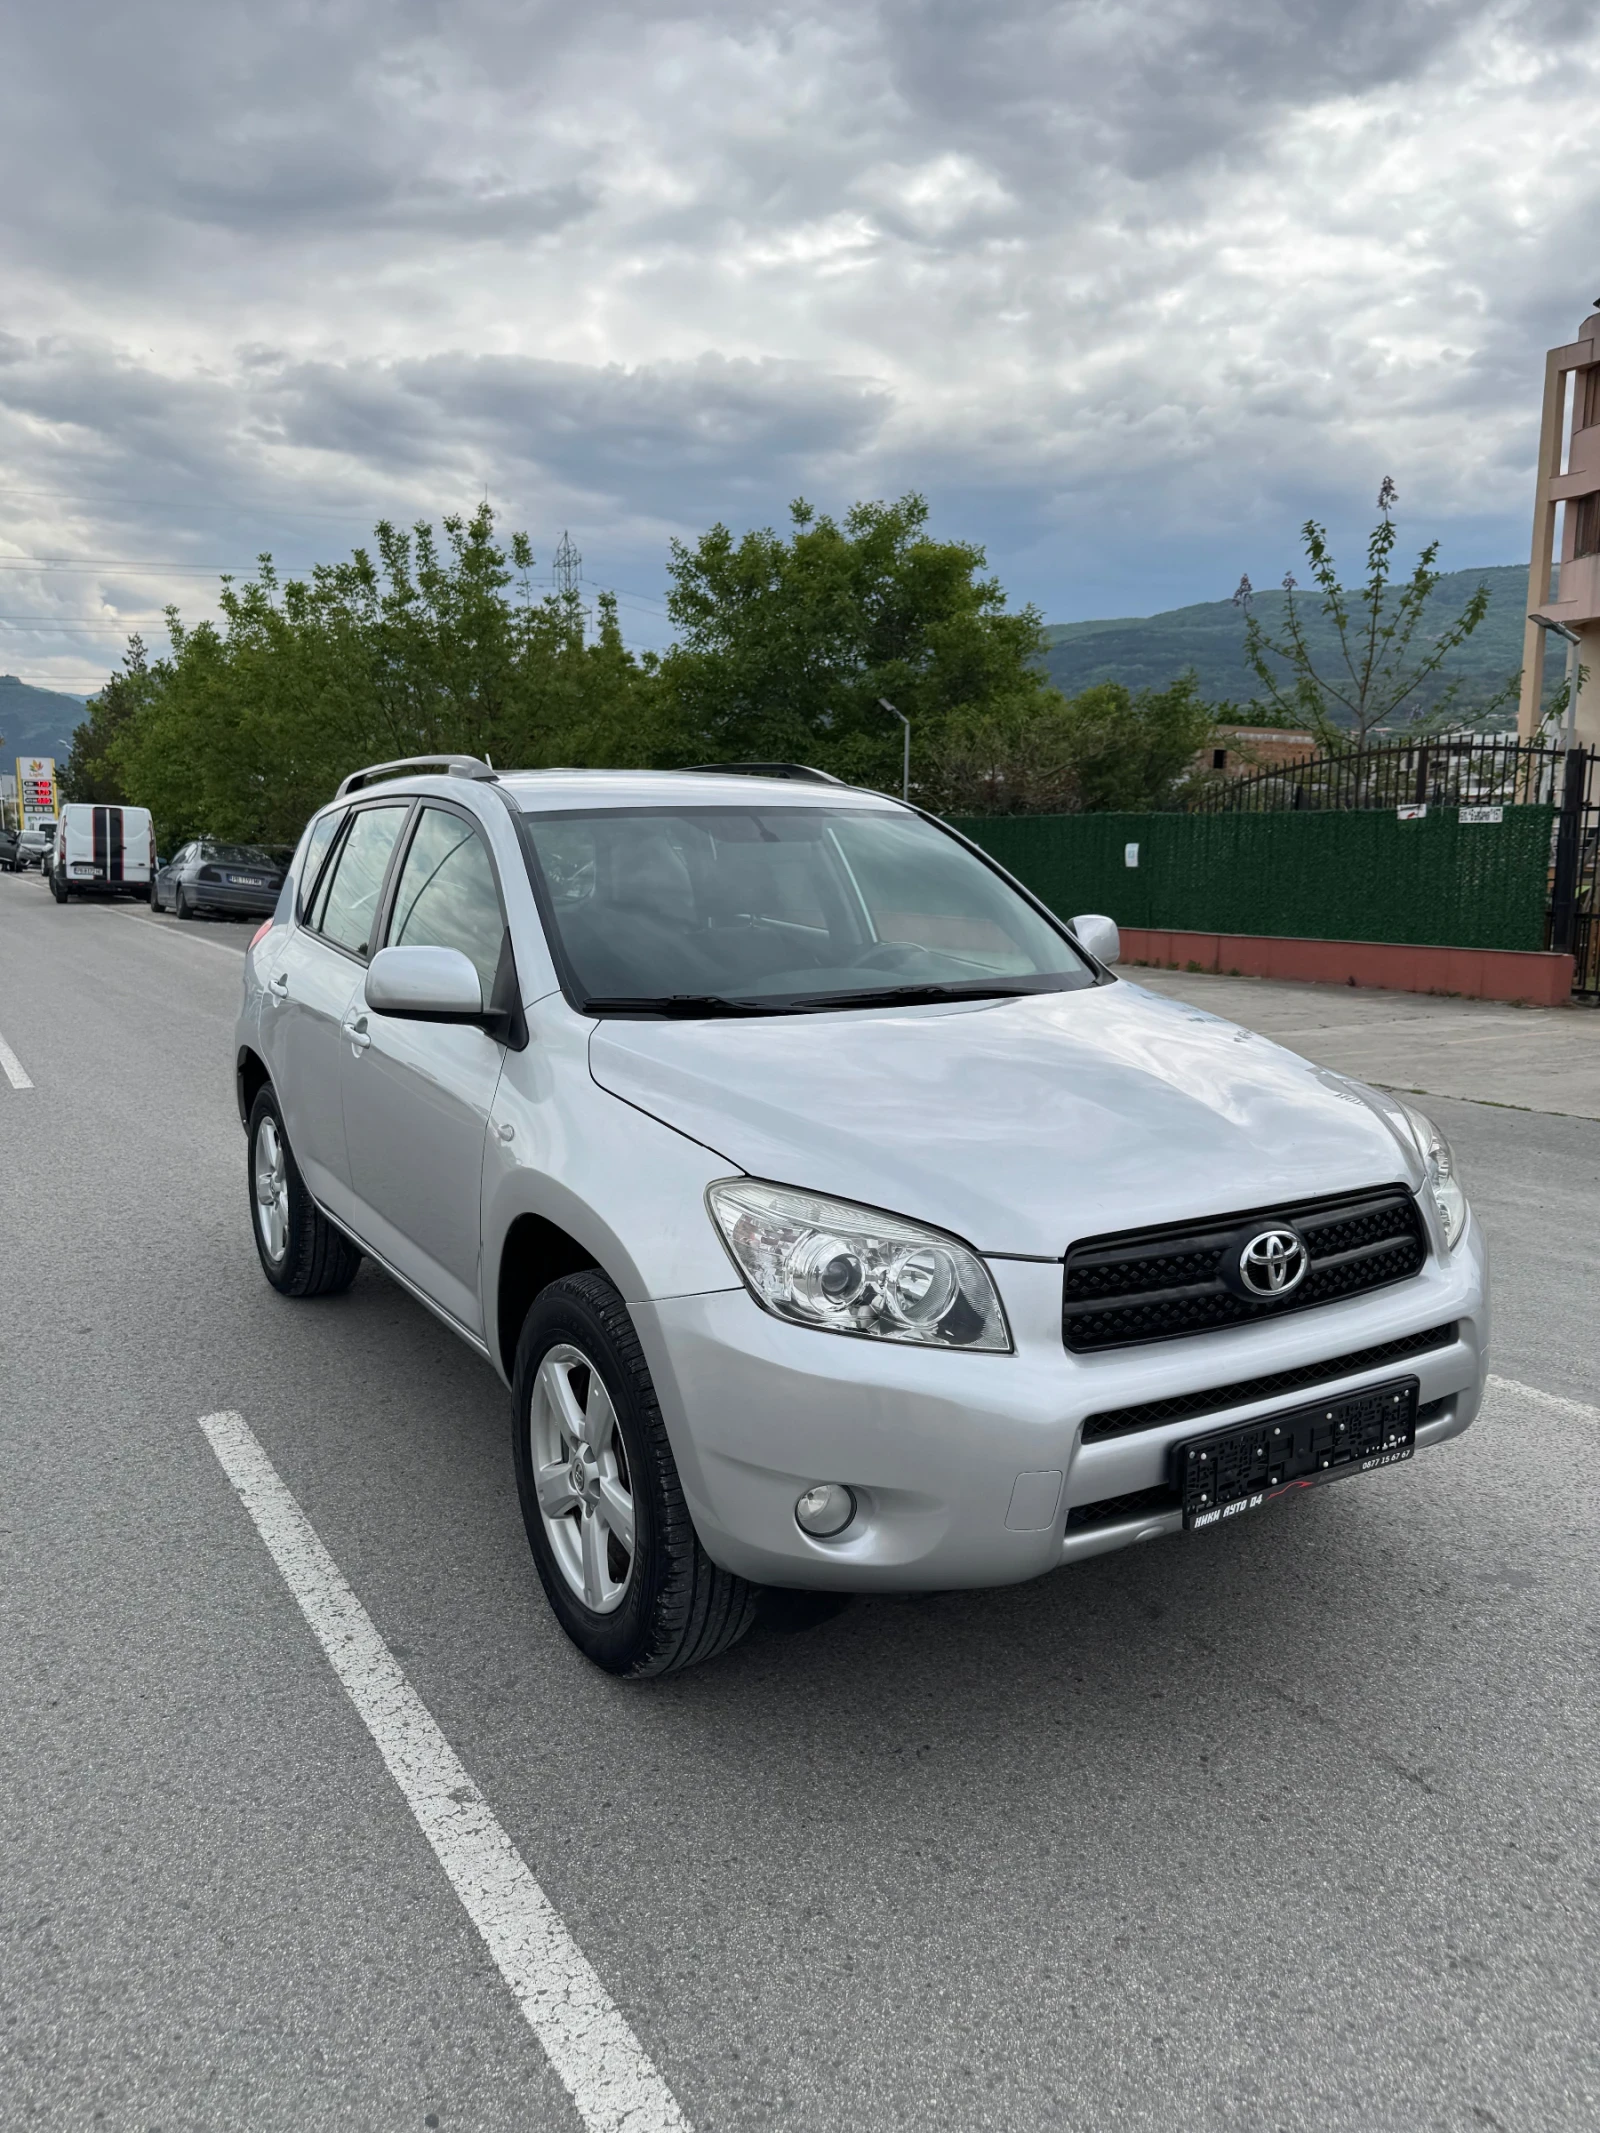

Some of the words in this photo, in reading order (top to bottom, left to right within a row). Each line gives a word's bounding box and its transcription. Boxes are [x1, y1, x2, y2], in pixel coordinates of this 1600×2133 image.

[1362, 1458, 1380, 1470] 0877
[1381, 1455, 1390, 1464] 15
[1391, 1452, 1400, 1461] 67
[1401, 1449, 1411, 1458] 67
[1194, 1509, 1221, 1529] НИКИ
[1249, 1493, 1263, 1508] 04
